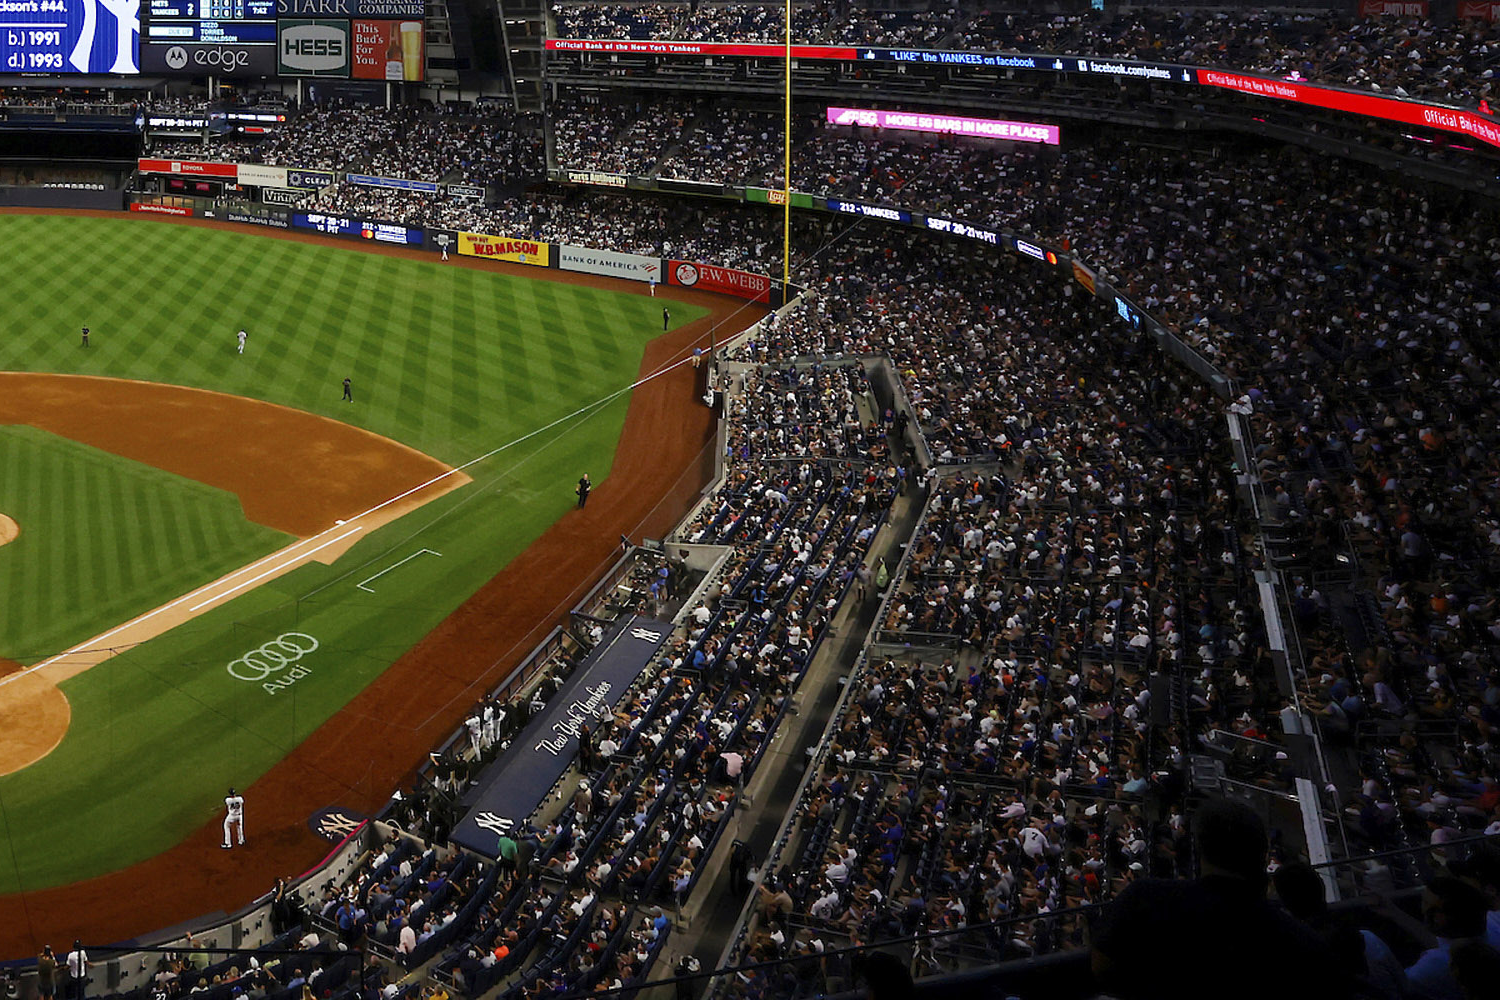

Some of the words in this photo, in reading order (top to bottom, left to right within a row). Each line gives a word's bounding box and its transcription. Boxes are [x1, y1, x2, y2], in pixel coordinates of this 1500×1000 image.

[40, 0, 68, 12] #44.
[358, 5, 424, 15] COMPANIES
[355, 23, 379, 34] This
[8, 30, 26, 46] b.)
[28, 31, 60, 46] 1991
[355, 33, 384, 44] Bud's
[285, 38, 342, 56] HESS
[355, 44, 373, 54] For
[8, 52, 26, 69] d.)
[28, 52, 63, 68] 1993
[194, 46, 249, 71] edge
[355, 55, 378, 65] You.
[922, 52, 937, 61] the
[939, 53, 982, 65] YANKEES
[984, 57, 995, 65] on
[996, 55, 1036, 68] facebook
[1090, 61, 1171, 79] facebook.com/yankees
[1424, 110, 1457, 127] Official
[885, 114, 917, 127] MORE
[918, 117, 933, 128] 5G
[933, 118, 961, 132] BARS
[963, 120, 975, 132] IN
[976, 122, 1009, 136] MORE
[1010, 125, 1050, 140] PLACES
[304, 177, 331, 186] CLEAR
[840, 202, 855, 213] 212
[861, 205, 900, 220] YANKEES
[307, 214, 326, 225] SEPT
[327, 224, 339, 234] PIT
[378, 224, 407, 235] YANKEES
[927, 217, 951, 232] SEPT
[984, 231, 997, 244] PIT
[562, 255, 585, 263] BANK
[587, 257, 596, 265] OF
[599, 259, 638, 271] AMERICA
[700, 267, 724, 283] F.W.
[727, 274, 765, 291] WEBB
[262, 664, 312, 695] Audi
[535, 737, 568, 756] New
[553, 709, 587, 739] York
[570, 680, 612, 718] Yankees
